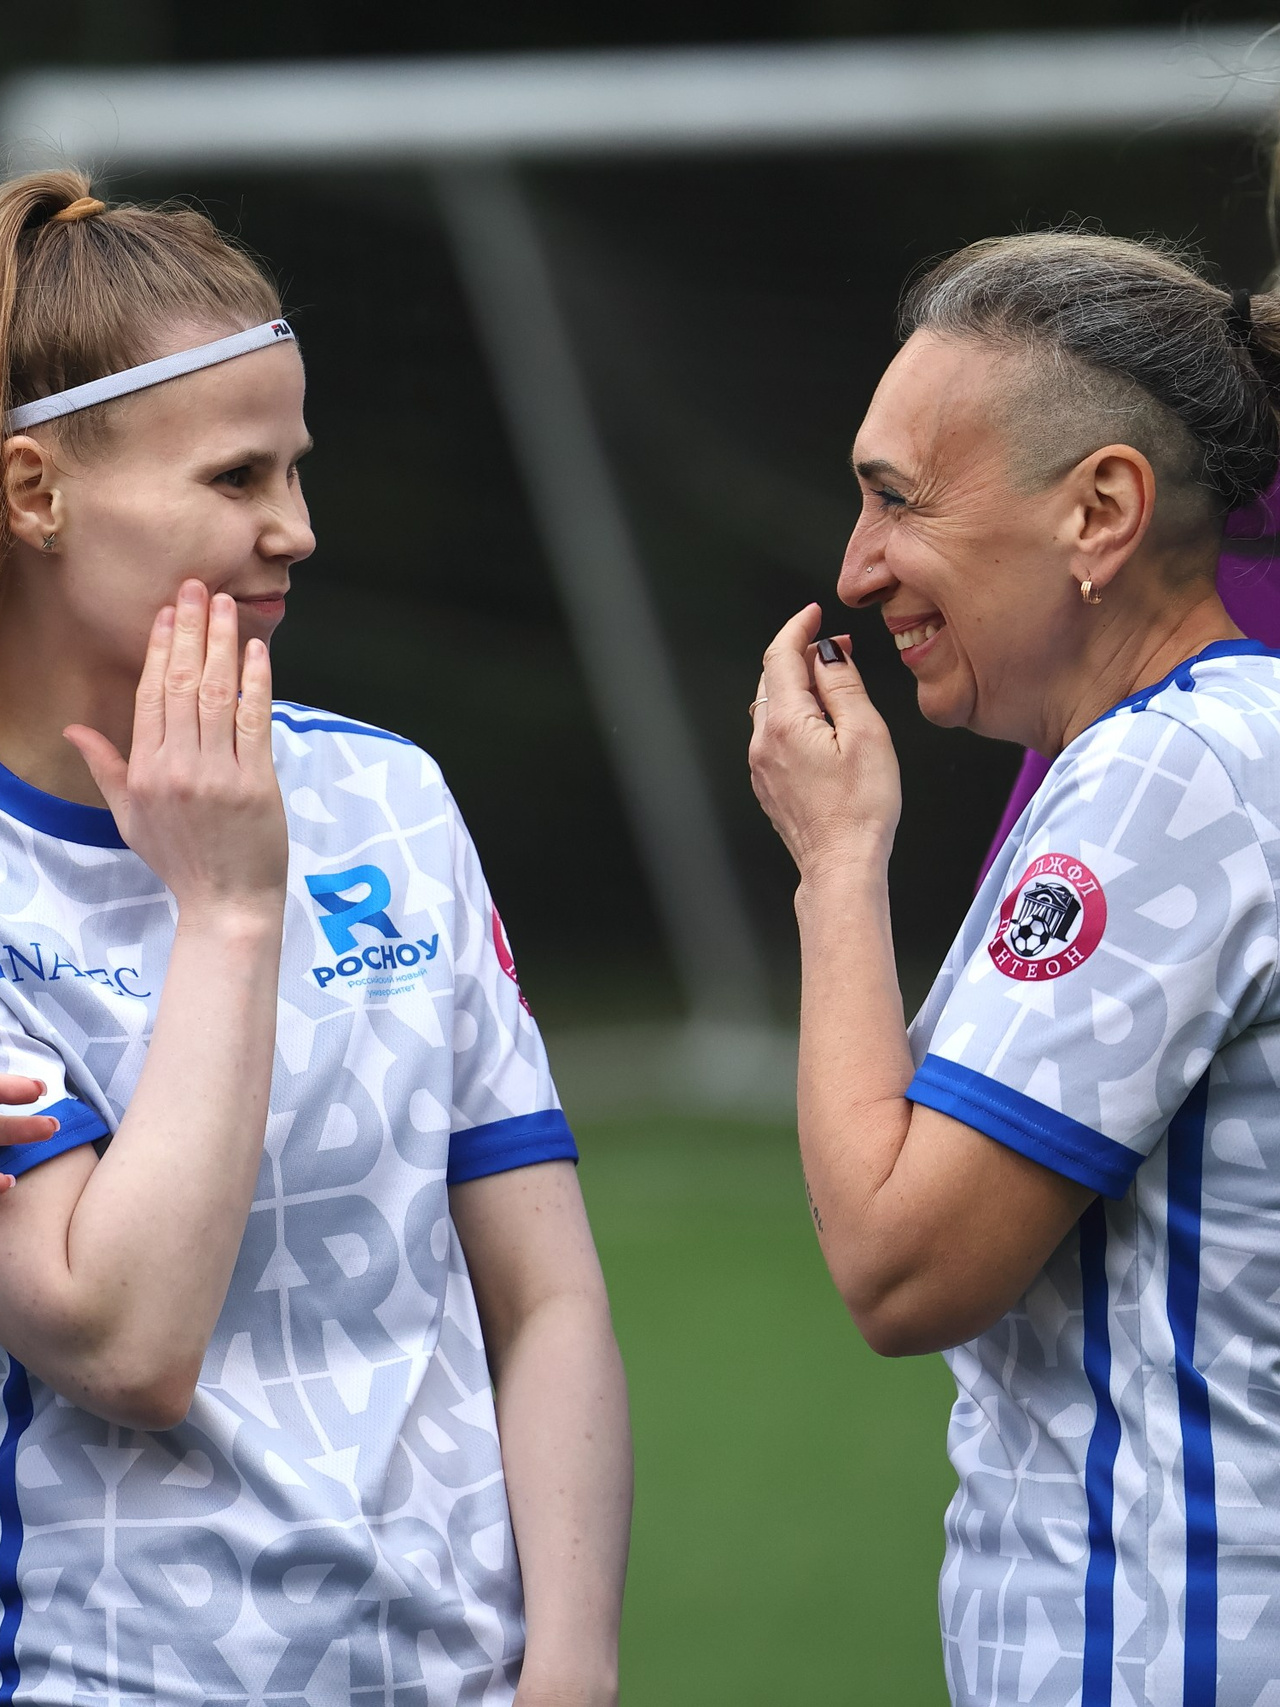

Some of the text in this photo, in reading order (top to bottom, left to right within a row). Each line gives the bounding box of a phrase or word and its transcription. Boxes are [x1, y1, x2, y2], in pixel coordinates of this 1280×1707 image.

[1031, 856, 1099, 898] ЛЖФЛ
[304, 864, 403, 957] R
[312, 933, 439, 989] РОСНОУ
